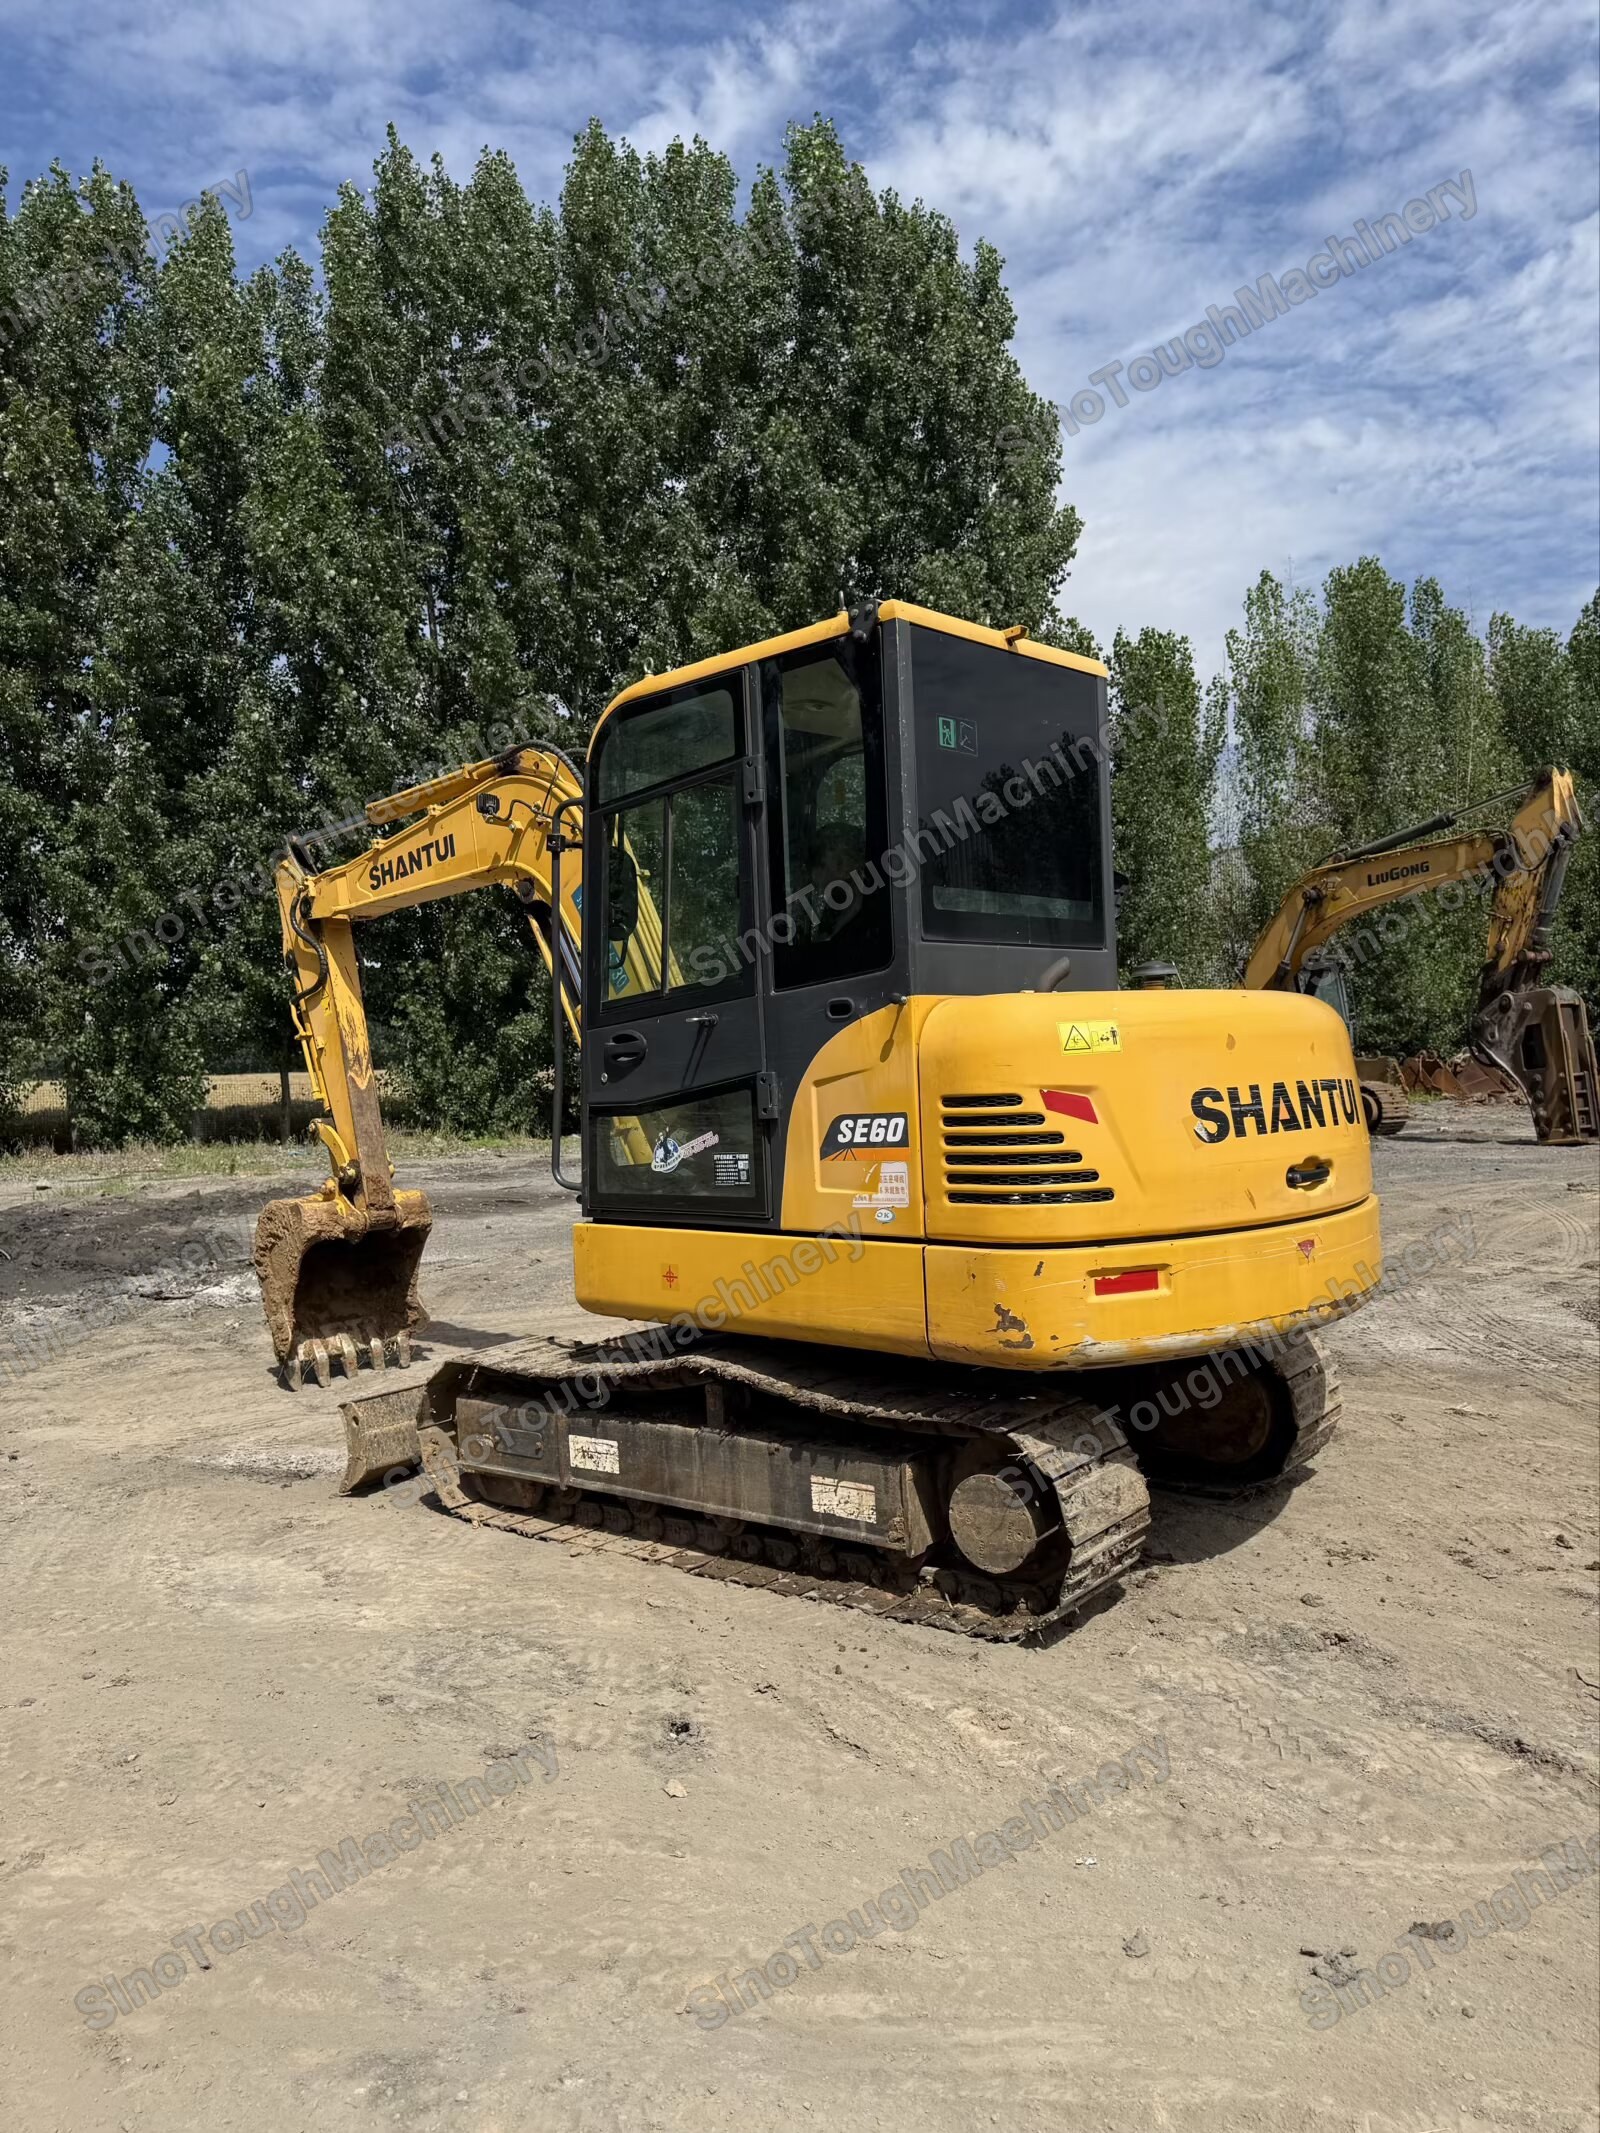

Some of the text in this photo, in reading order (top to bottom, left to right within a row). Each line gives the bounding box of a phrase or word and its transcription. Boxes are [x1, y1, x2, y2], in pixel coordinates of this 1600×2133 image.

[368, 833, 456, 891] SHANTUI
[837, 1117, 905, 1143] SE60
[1190, 1078, 1361, 1144] SHANTUI
[876, 1211, 890, 1219] OK
